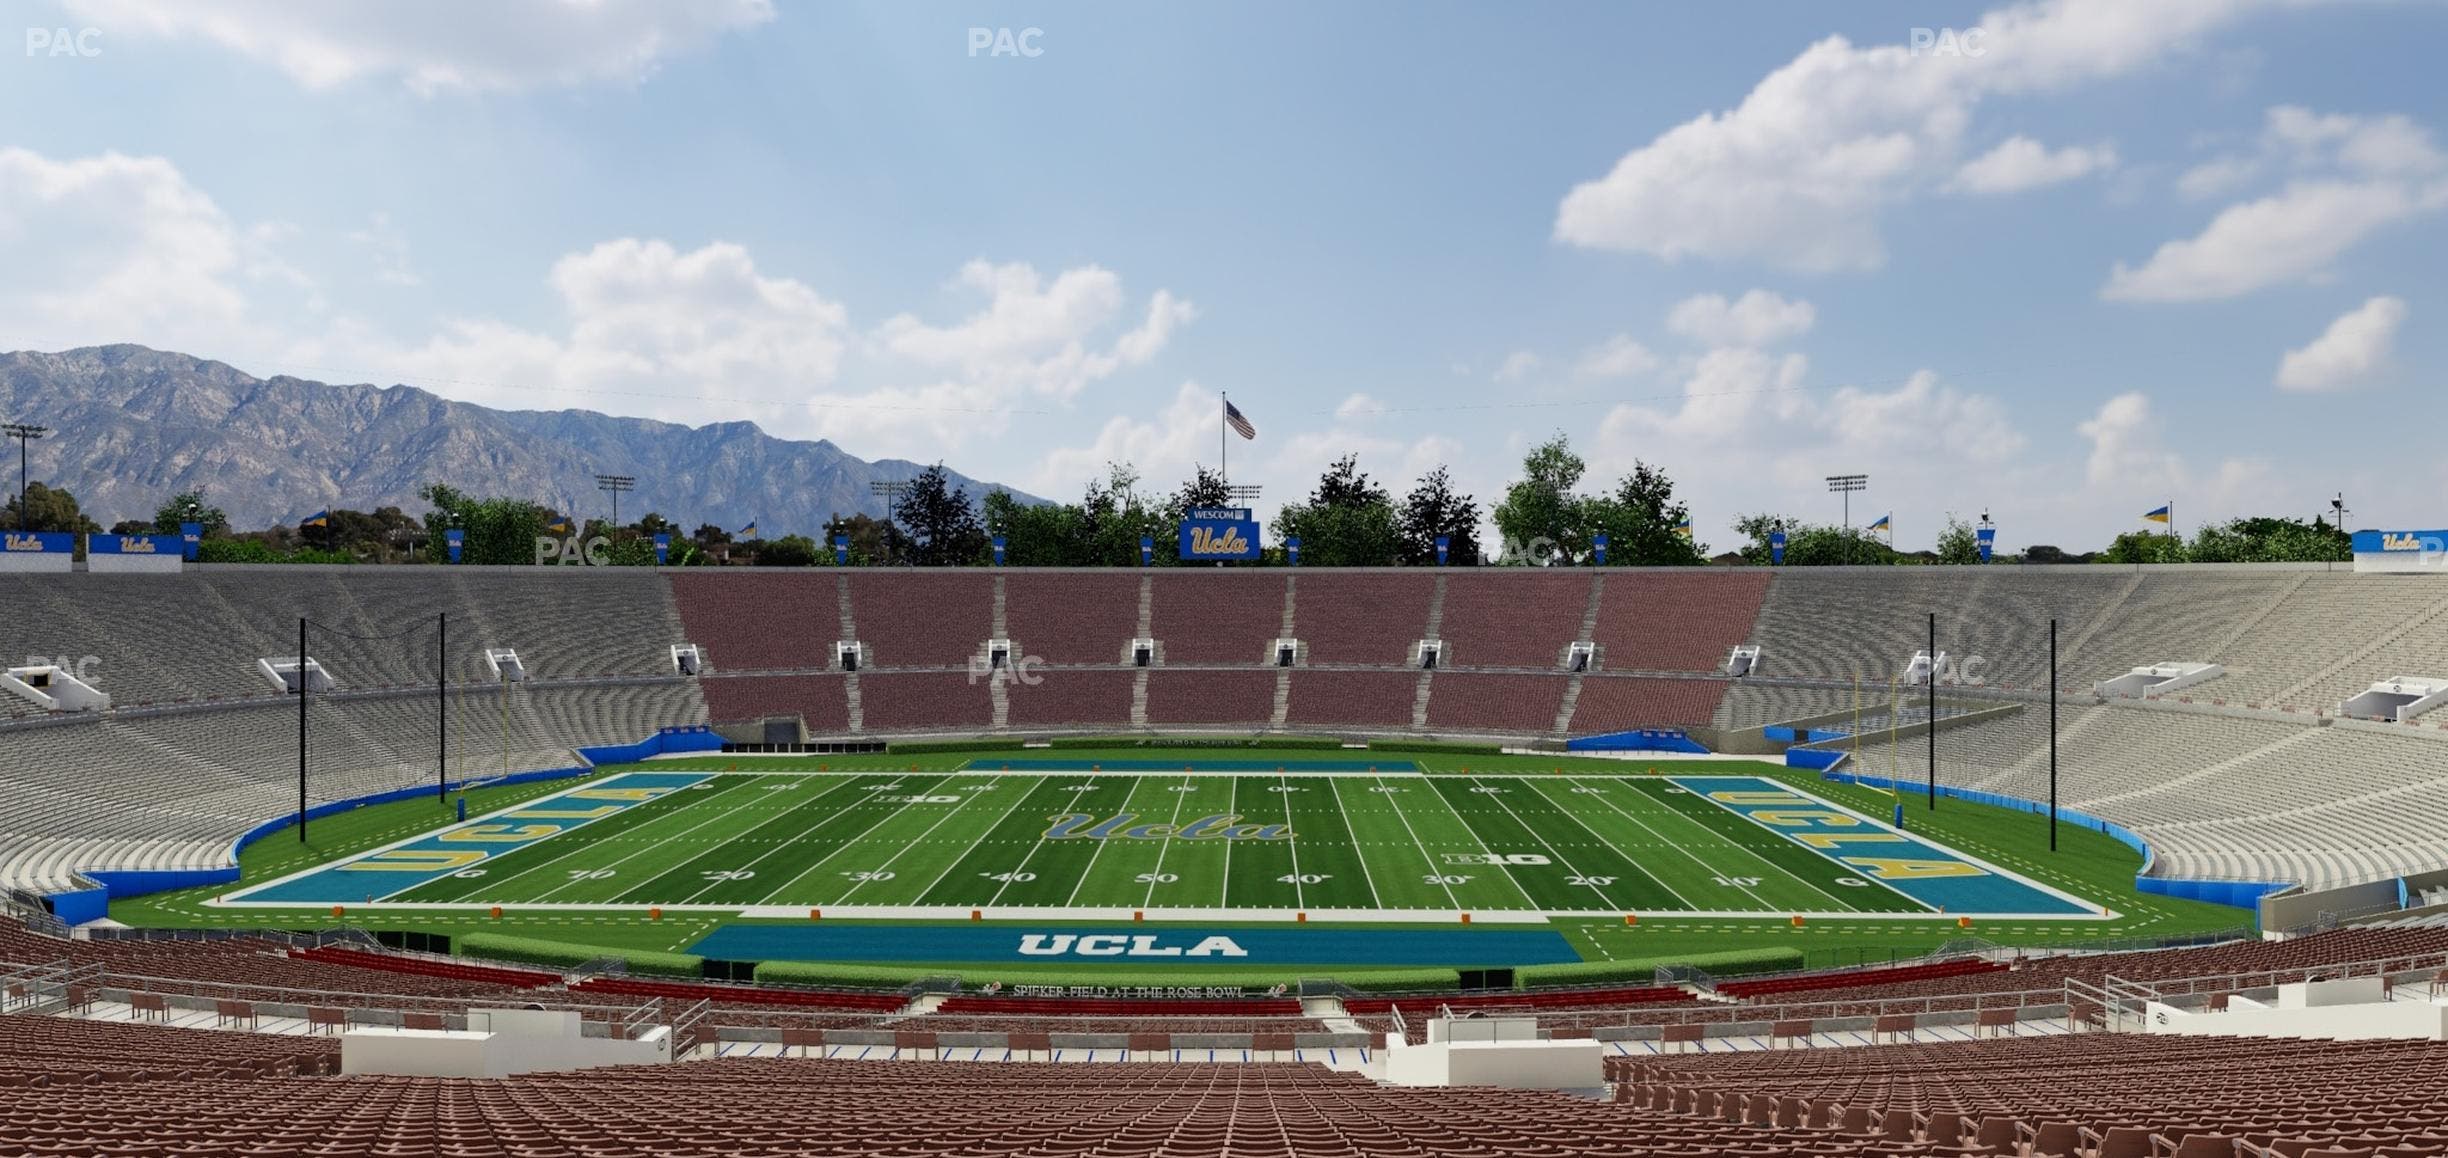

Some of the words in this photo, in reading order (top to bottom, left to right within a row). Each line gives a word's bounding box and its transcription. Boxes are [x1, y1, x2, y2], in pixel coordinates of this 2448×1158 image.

[1194, 510, 1234, 520] WESCOM
[335, 787, 676, 872] UCLA
[1707, 791, 1993, 880] UCLA
[568, 870, 616, 879] 10
[703, 871, 756, 880] 20
[848, 871, 896, 881] 30
[990, 872, 1037, 882] 40
[1133, 873, 1179, 883] 50
[1276, 874, 1322, 884] 40
[1422, 875, 1468, 885] 30
[1563, 876, 1612, 886] 20
[1711, 877, 1759, 887] 10
[1018, 934, 1249, 957] UCLA
[1013, 985, 1064, 998] SPIEKER
[1070, 986, 1108, 998] FIELD
[1112, 987, 1130, 998] AT
[1136, 987, 1163, 998] THE
[1167, 987, 1201, 998] ROSE
[1206, 987, 1246, 998] BOWL
